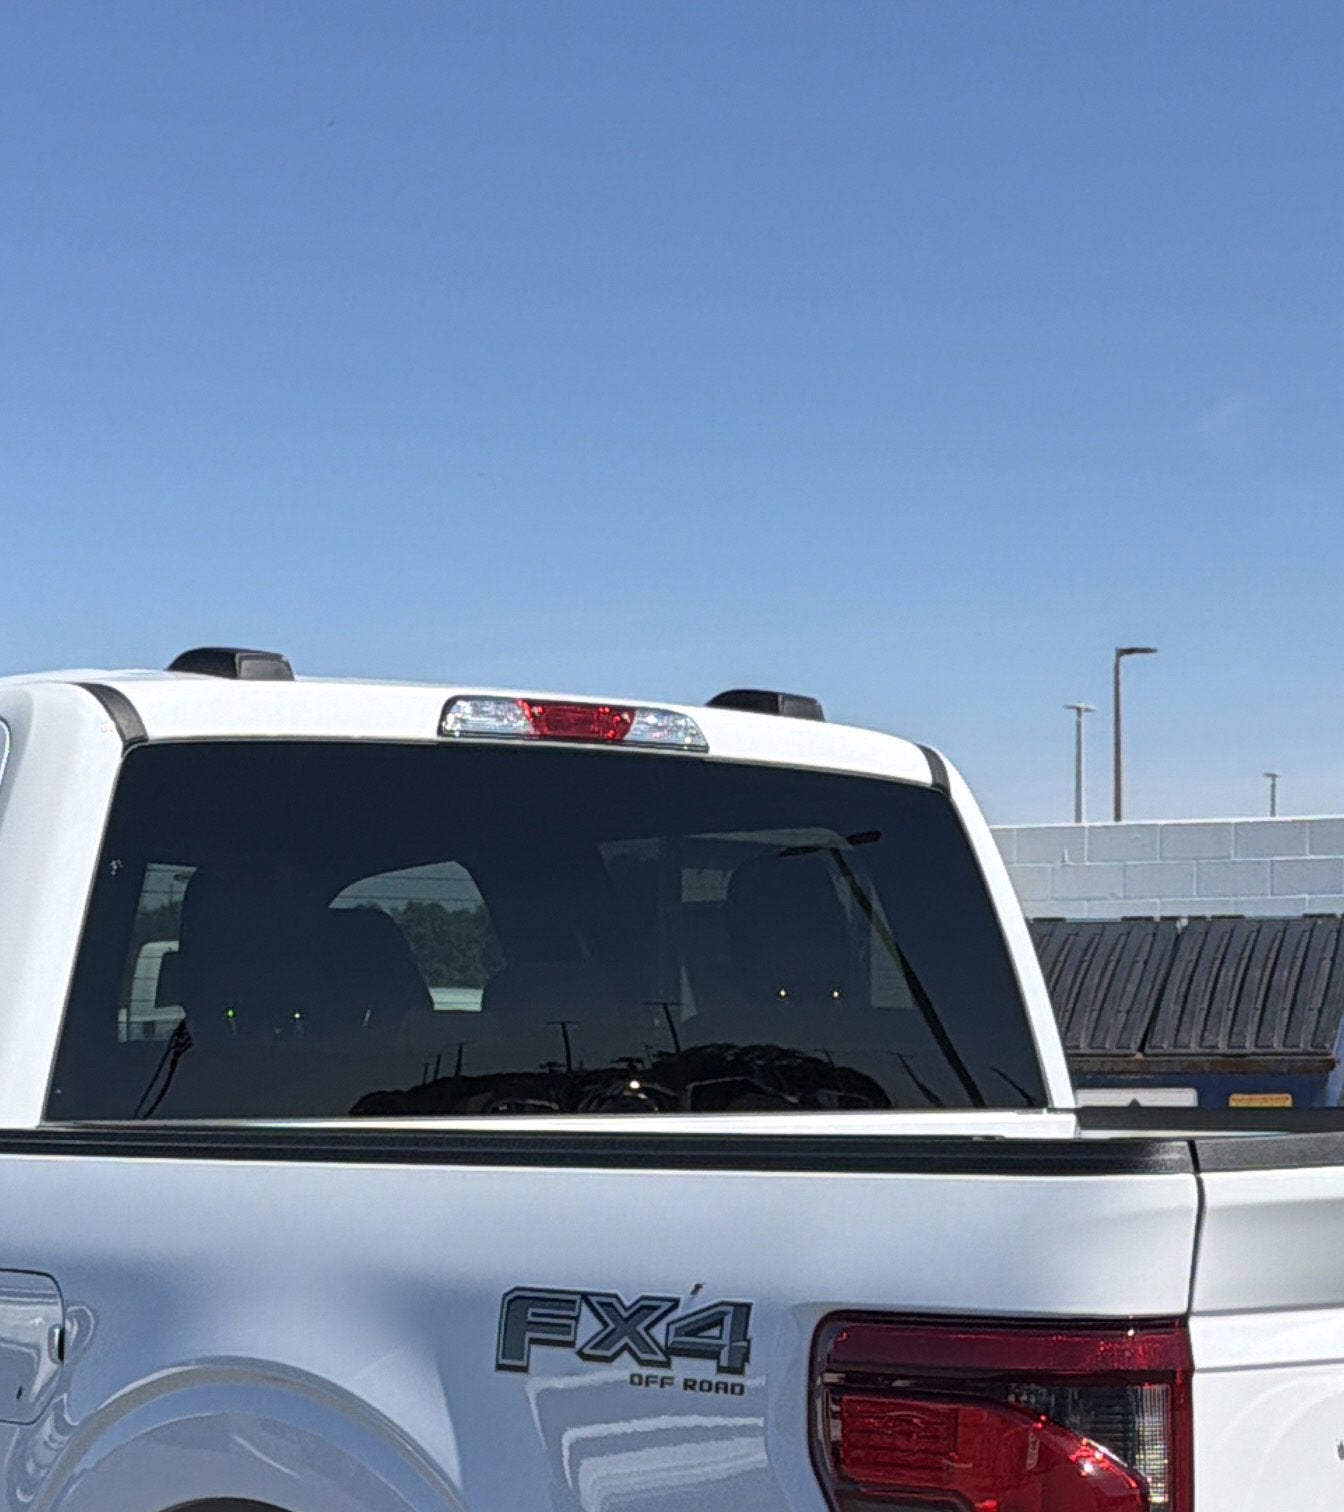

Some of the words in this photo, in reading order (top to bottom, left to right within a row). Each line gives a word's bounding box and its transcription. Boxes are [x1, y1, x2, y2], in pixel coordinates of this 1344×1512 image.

[495, 1286, 754, 1376] FX4
[629, 1373, 675, 1389] OFF
[683, 1377, 746, 1396] ROAD
